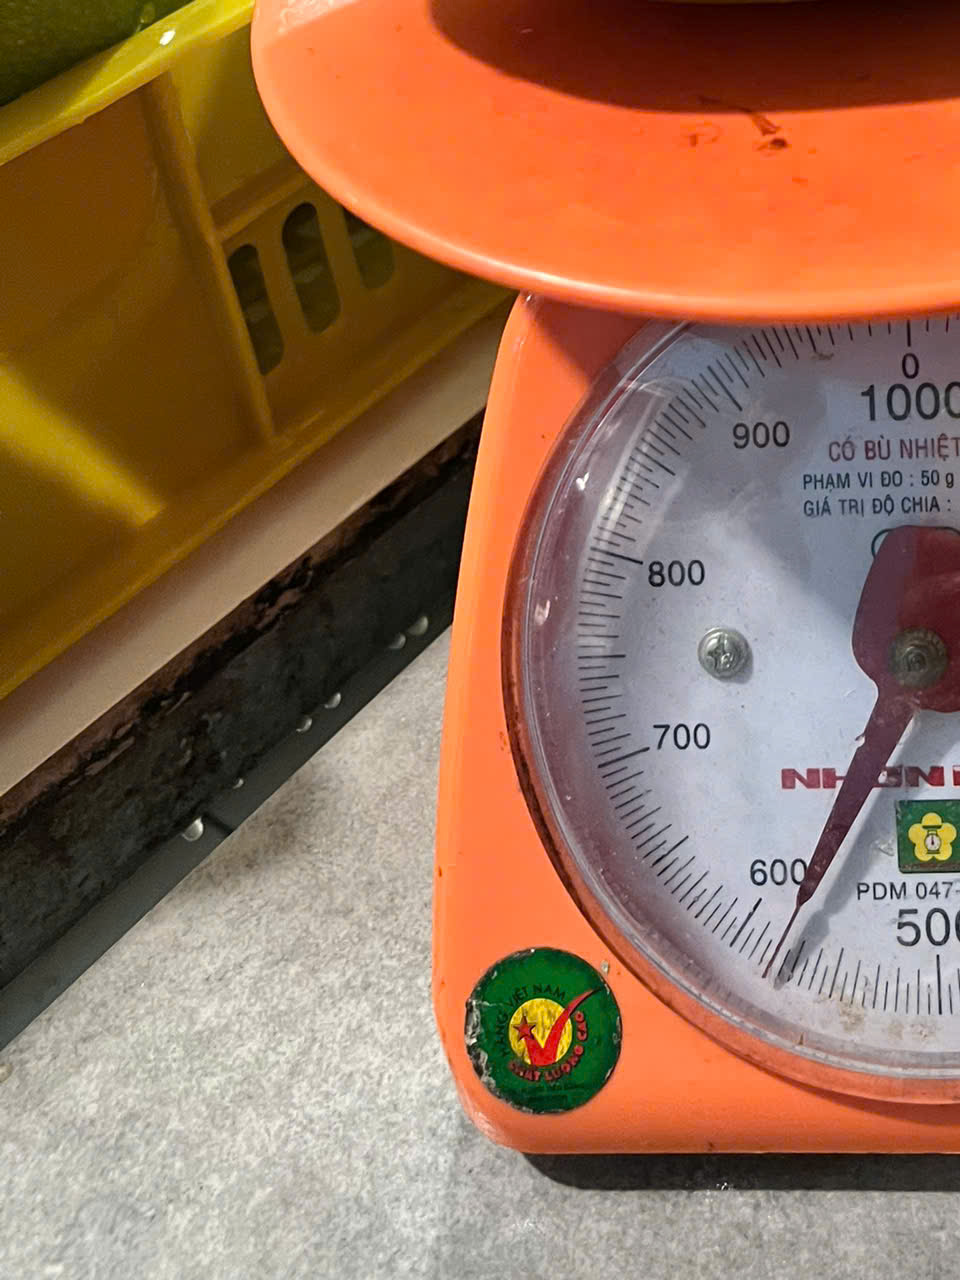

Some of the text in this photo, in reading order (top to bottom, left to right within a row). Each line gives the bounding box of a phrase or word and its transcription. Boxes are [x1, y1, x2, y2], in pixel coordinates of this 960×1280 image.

[902, 353, 919, 379] 0
[732, 422, 790, 449] 900
[829, 435, 855, 462] CÓ
[864, 434, 891, 460] BÙ
[803, 473, 850, 493] PHẠM
[858, 472, 873, 488] VI
[921, 469, 940, 487] 50
[945, 472, 954, 489] g
[803, 495, 831, 517] GIÁ
[872, 494, 895, 517] ĐỘ
[901, 496, 940, 514] CHIA
[647, 560, 706, 587] 800
[653, 723, 711, 751] 700
[749, 858, 808, 887] 600
[856, 882, 908, 901] PDM
